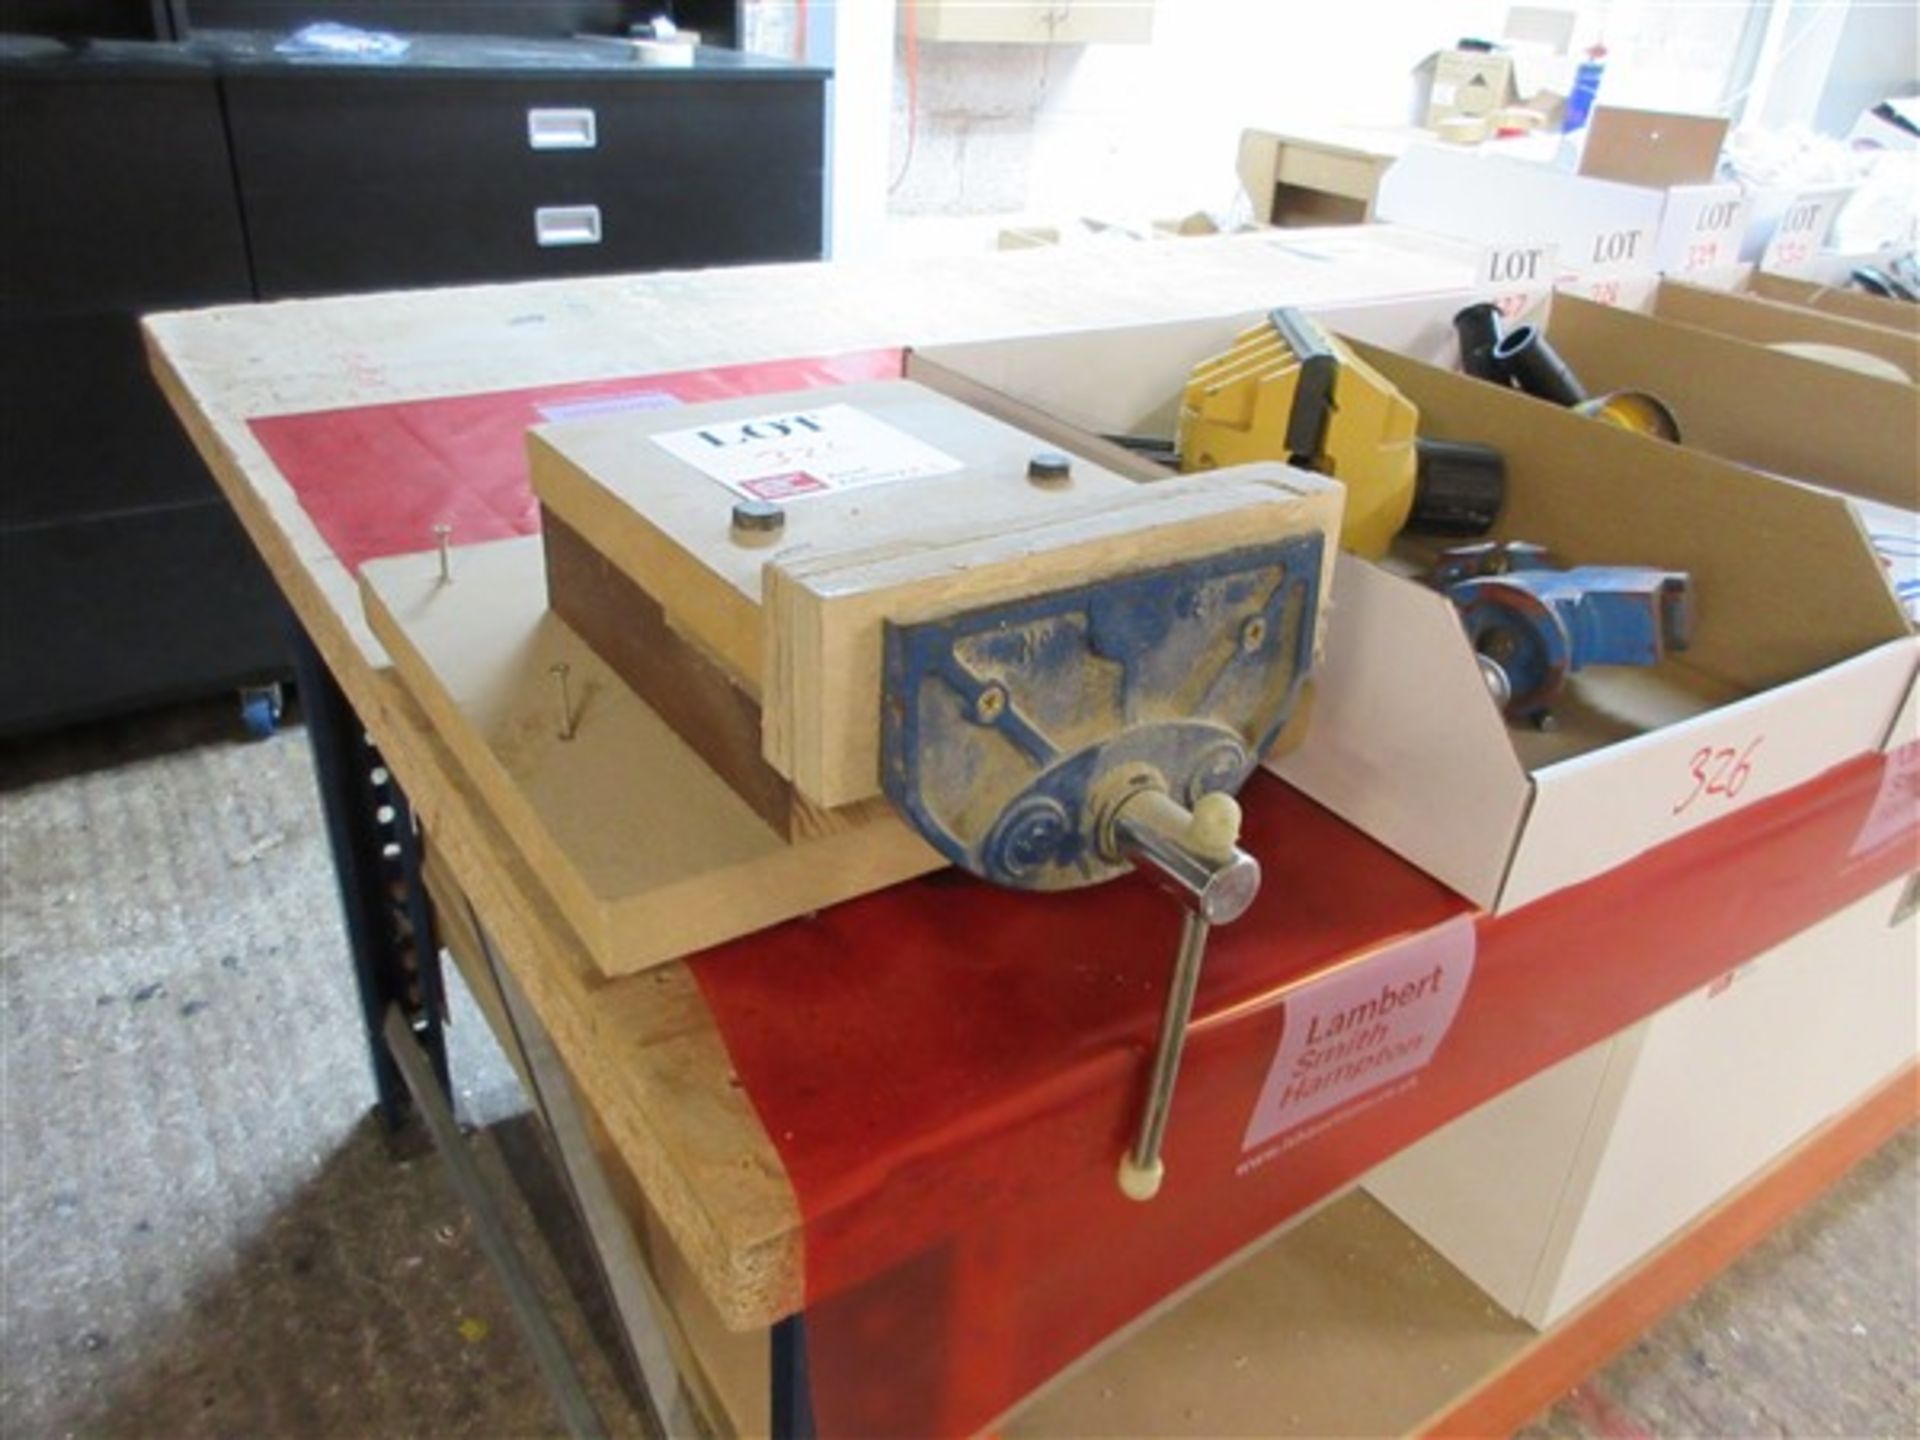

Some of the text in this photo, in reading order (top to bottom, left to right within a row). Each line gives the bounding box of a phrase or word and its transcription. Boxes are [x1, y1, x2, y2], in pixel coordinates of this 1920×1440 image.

[1695, 202, 1740, 231] LOT
[1781, 204, 1822, 233] LOT
[1593, 229, 1642, 262] LOT
[1489, 249, 1543, 282] LOT
[696, 414, 823, 448] LOT
[1673, 735, 1766, 816] 326
[1305, 962, 1443, 1046] Lambert
[1292, 1022, 1390, 1079] Smith
[1279, 1034, 1426, 1111] Hampton
